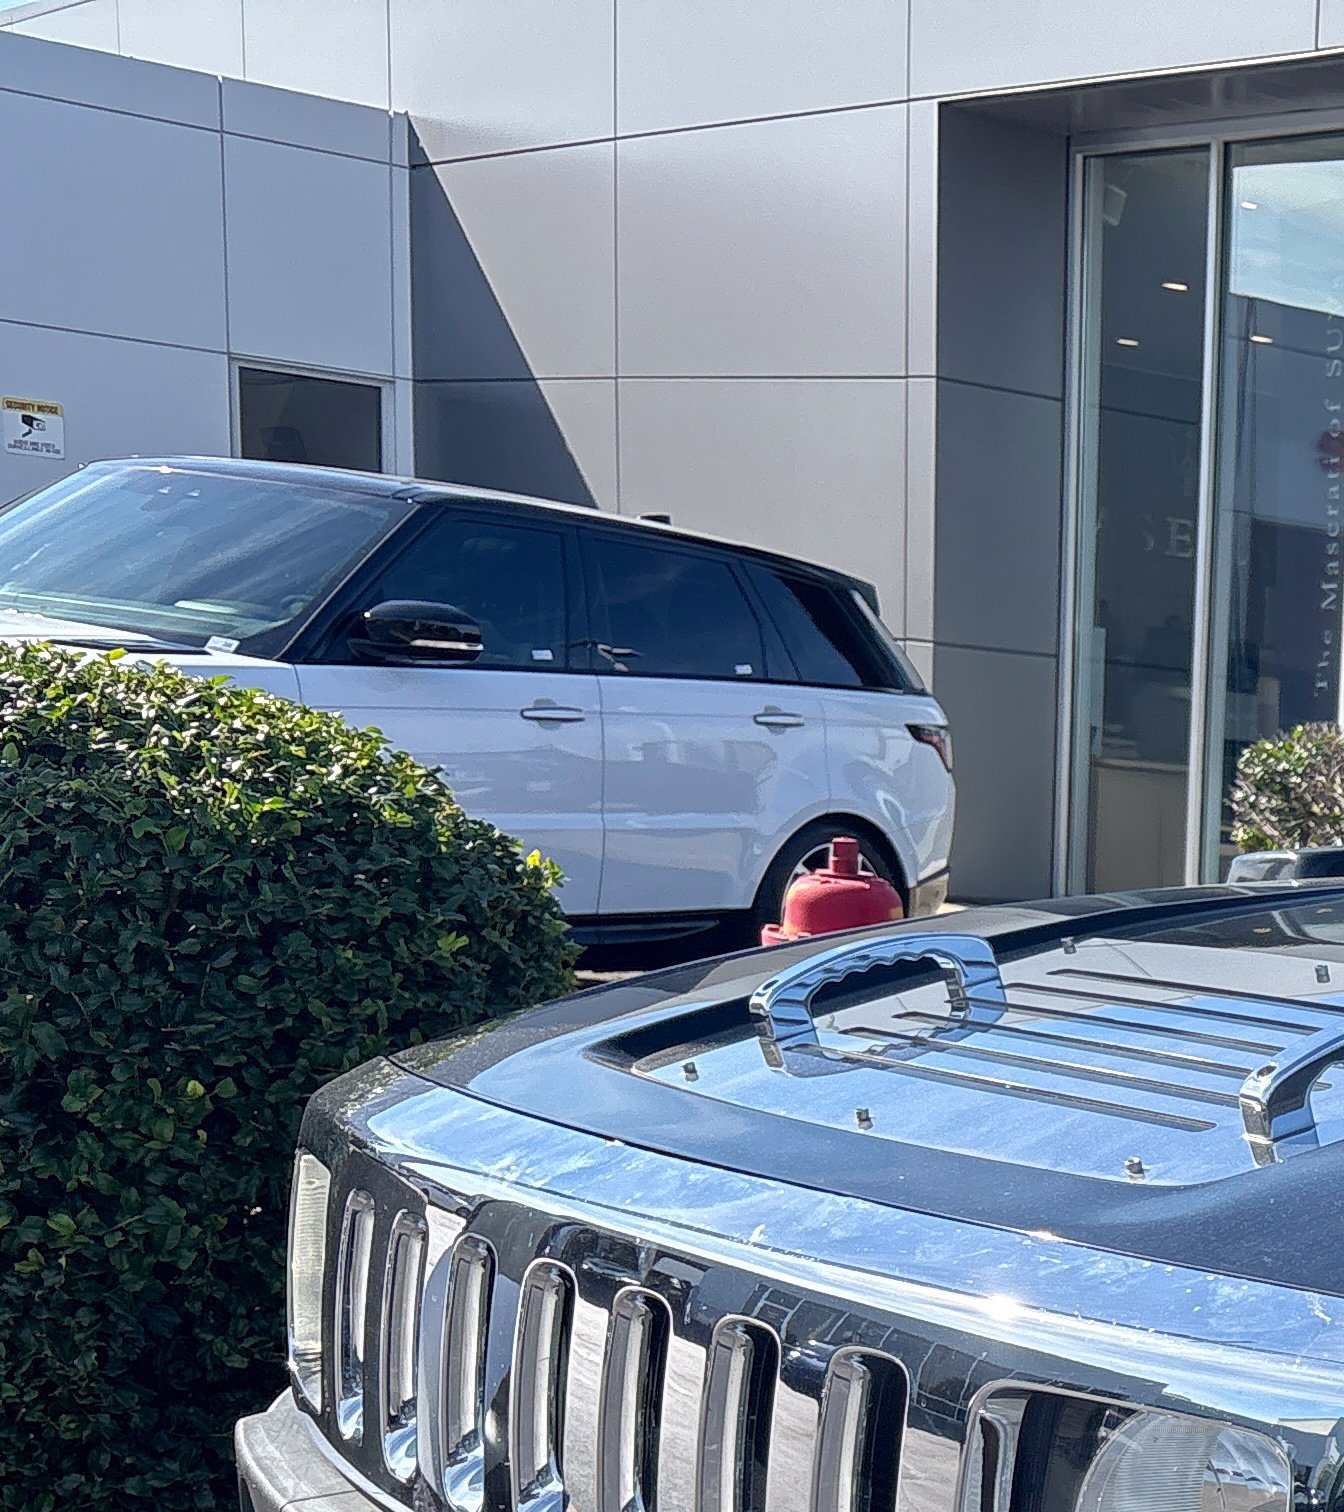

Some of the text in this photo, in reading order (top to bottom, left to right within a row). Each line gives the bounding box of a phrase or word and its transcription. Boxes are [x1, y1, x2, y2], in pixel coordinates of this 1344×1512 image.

[1323, 398, 1342, 438] of
[1319, 455, 1341, 611] Maserati
[1313, 628, 1334, 698] The
